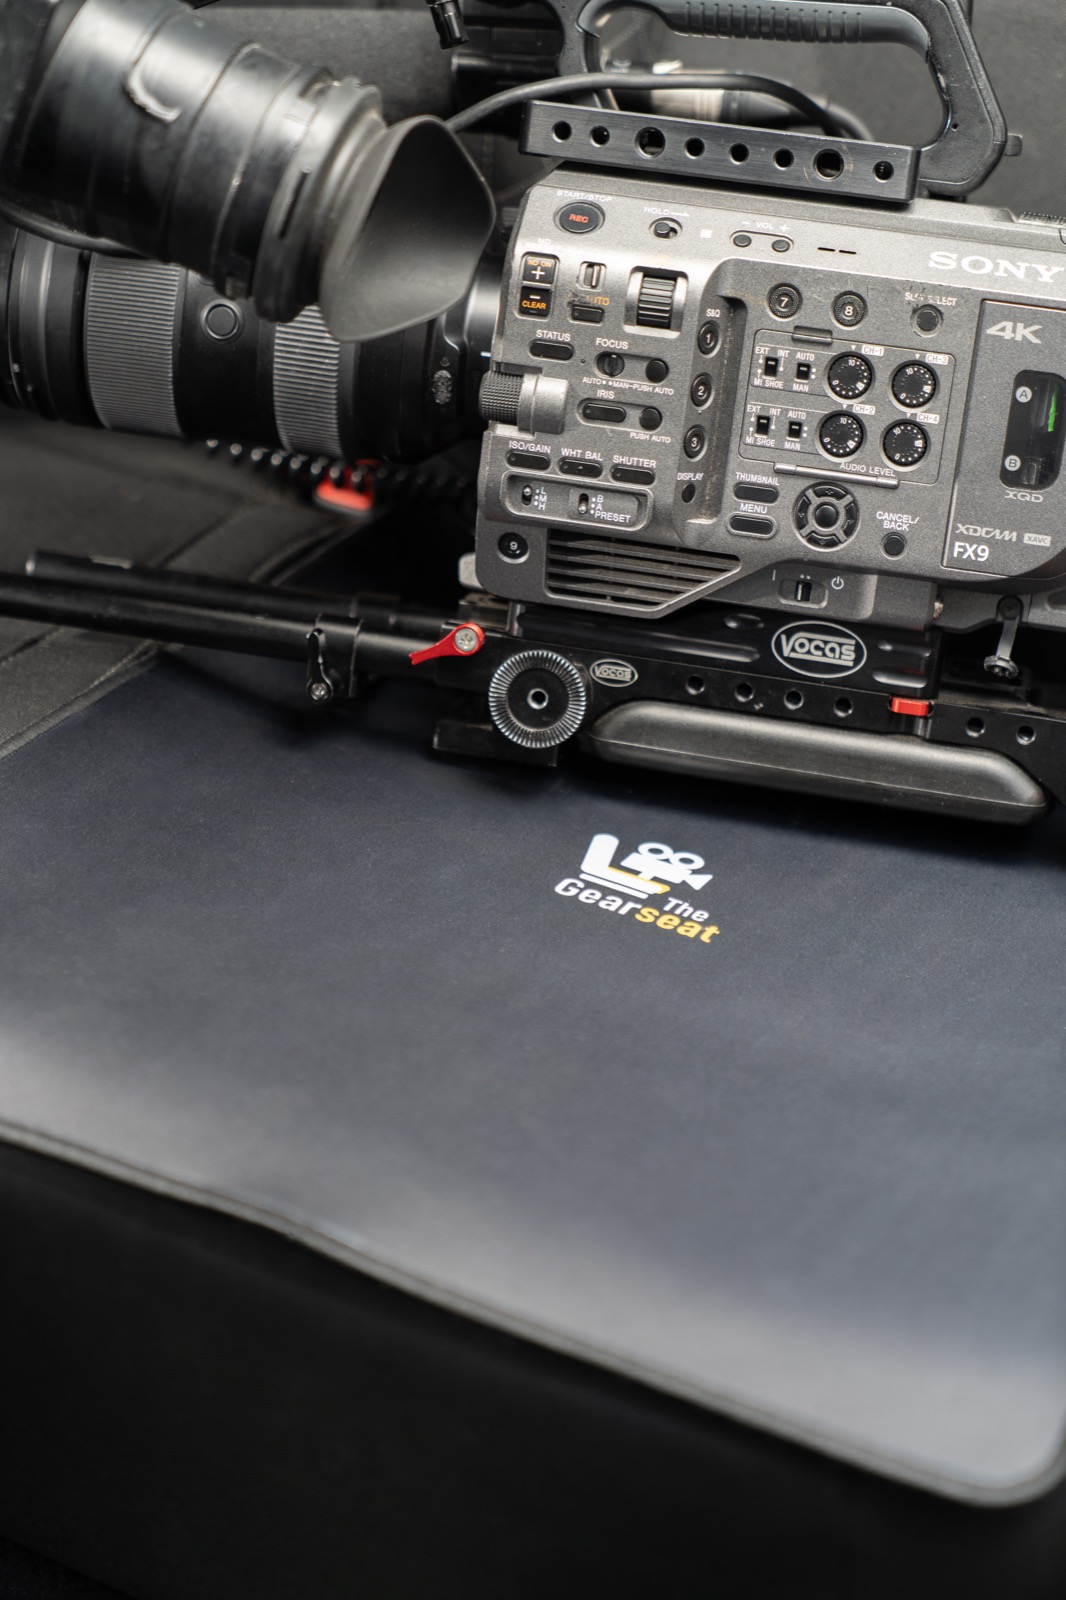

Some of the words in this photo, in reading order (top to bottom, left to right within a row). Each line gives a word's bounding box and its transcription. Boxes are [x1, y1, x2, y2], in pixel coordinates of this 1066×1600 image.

[556, 189, 613, 202] START/STOP
[643, 207, 670, 216] HOLD
[568, 214, 589, 223] REC
[756, 221, 774, 230] VOL
[928, 251, 1065, 283] SONY
[780, 298, 788, 308] 7
[904, 292, 925, 302] SL
[928, 295, 957, 306] SLECT
[522, 301, 547, 310] CLEAR
[706, 308, 720, 318] S&Q
[844, 306, 854, 316] 8
[536, 330, 571, 342] STATUS
[986, 321, 1043, 344] 4K
[706, 334, 711, 344] 1
[596, 338, 628, 350] FOCUS
[755, 347, 770, 355] EXT
[777, 350, 790, 358] INT
[863, 346, 883, 355] CH-1
[796, 352, 815, 361] AUTO
[926, 355, 948, 364] CH-3
[582, 377, 601, 385] AUTO
[764, 380, 784, 389] SHOE
[698, 386, 704, 396] 2
[792, 384, 810, 392] MAN
[596, 390, 615, 399] IRIS
[746, 405, 762, 413] EXT
[768, 408, 782, 416] INT
[854, 405, 874, 414] CH-2
[788, 410, 806, 419] AUTO
[918, 414, 938, 423] CH-4
[893, 427, 901, 436] 10
[630, 432, 650, 441] PUSH
[652, 434, 671, 444] AUTO
[690, 438, 698, 446] 3
[756, 438, 776, 446] SHOE
[508, 440, 551, 454] ISO/GAIN
[784, 442, 801, 450] MAN
[561, 448, 582, 458] WHT
[586, 451, 603, 461] BAL
[612, 454, 657, 468] SHUTTER
[840, 462, 866, 473] AUDIO
[869, 466, 896, 477] LEVEL
[677, 472, 704, 481] DISPLAY
[736, 472, 780, 486] THUMBNAIL
[541, 486, 546, 494] L
[539, 494, 547, 502] M
[597, 494, 604, 502] B
[1004, 490, 1044, 502] XQD
[538, 502, 546, 510] H
[740, 504, 768, 514] MENU
[594, 510, 631, 523] PRESET
[876, 512, 920, 524] CANCEL/
[883, 520, 910, 532] BACK
[956, 524, 1017, 542] XDCAM
[1026, 534, 1049, 544] XAVC
[510, 542, 518, 550] 9
[953, 542, 989, 562] FX9
[663, 897, 710, 922] The
